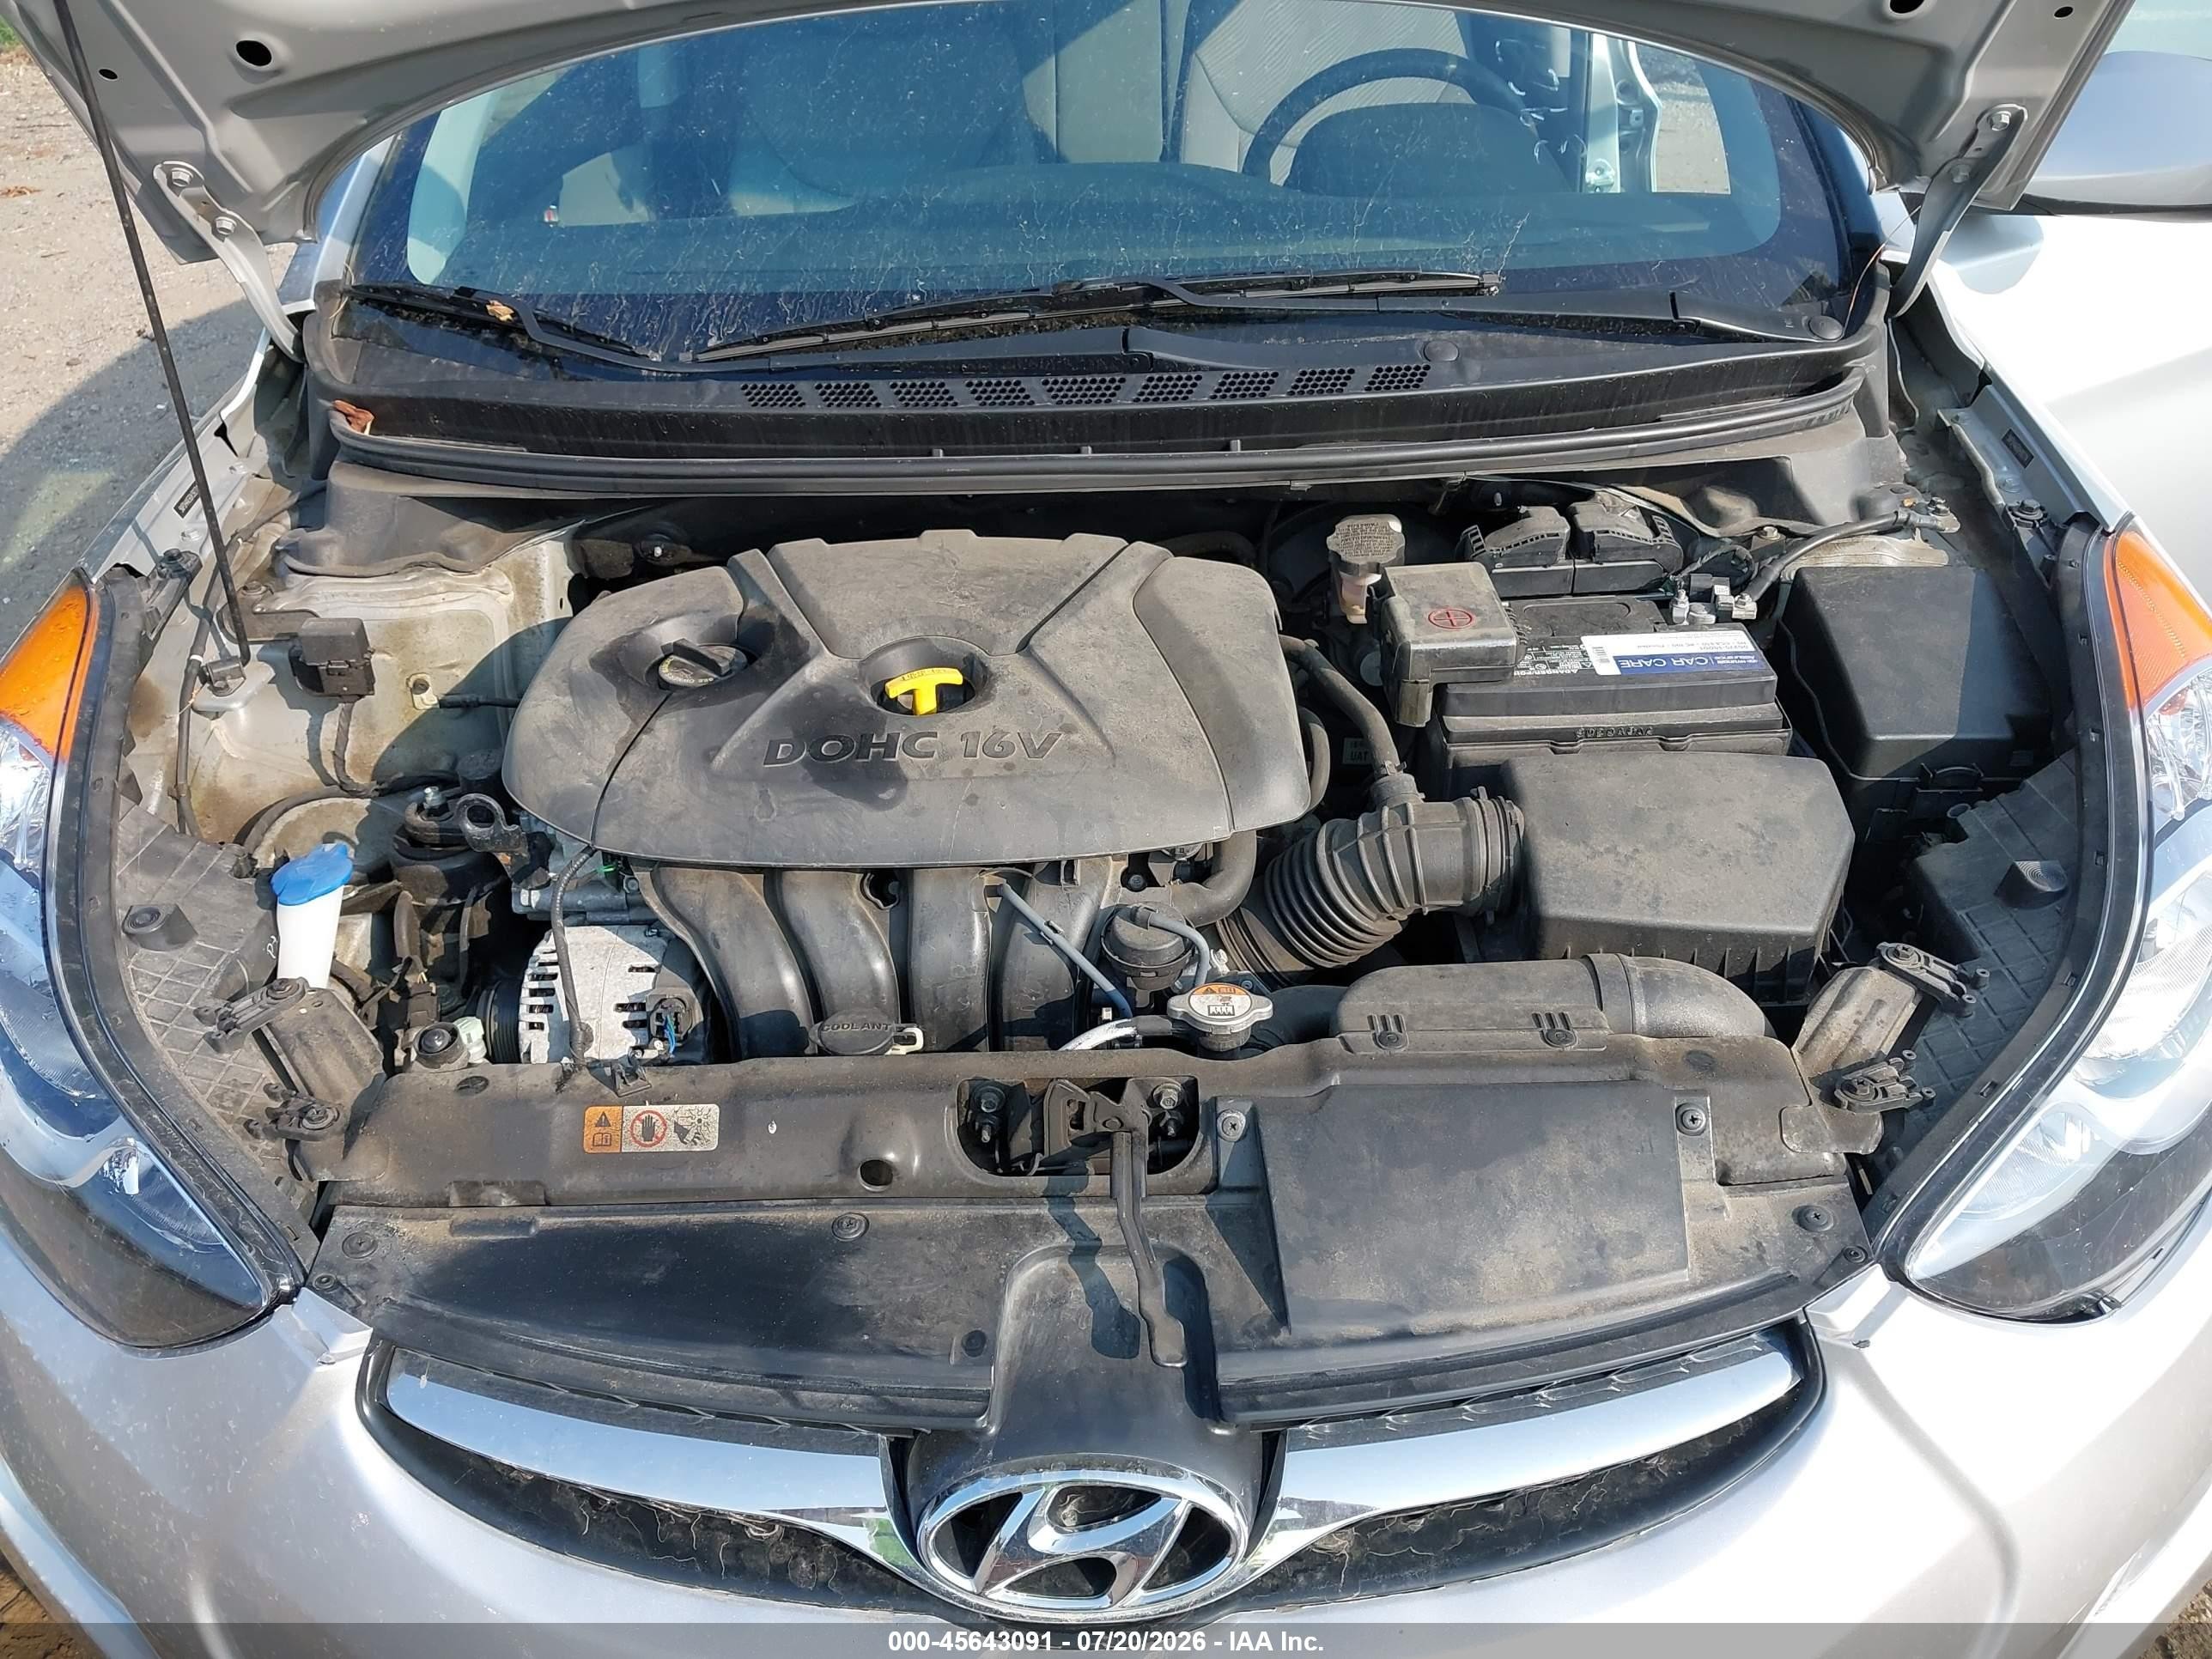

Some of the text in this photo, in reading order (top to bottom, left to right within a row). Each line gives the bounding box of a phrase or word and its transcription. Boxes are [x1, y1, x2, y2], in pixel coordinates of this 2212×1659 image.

[1618, 658, 1709, 669] CAR CARE
[763, 730, 1062, 768] DOHC 16V
[823, 1023, 892, 1032] COOLANT
